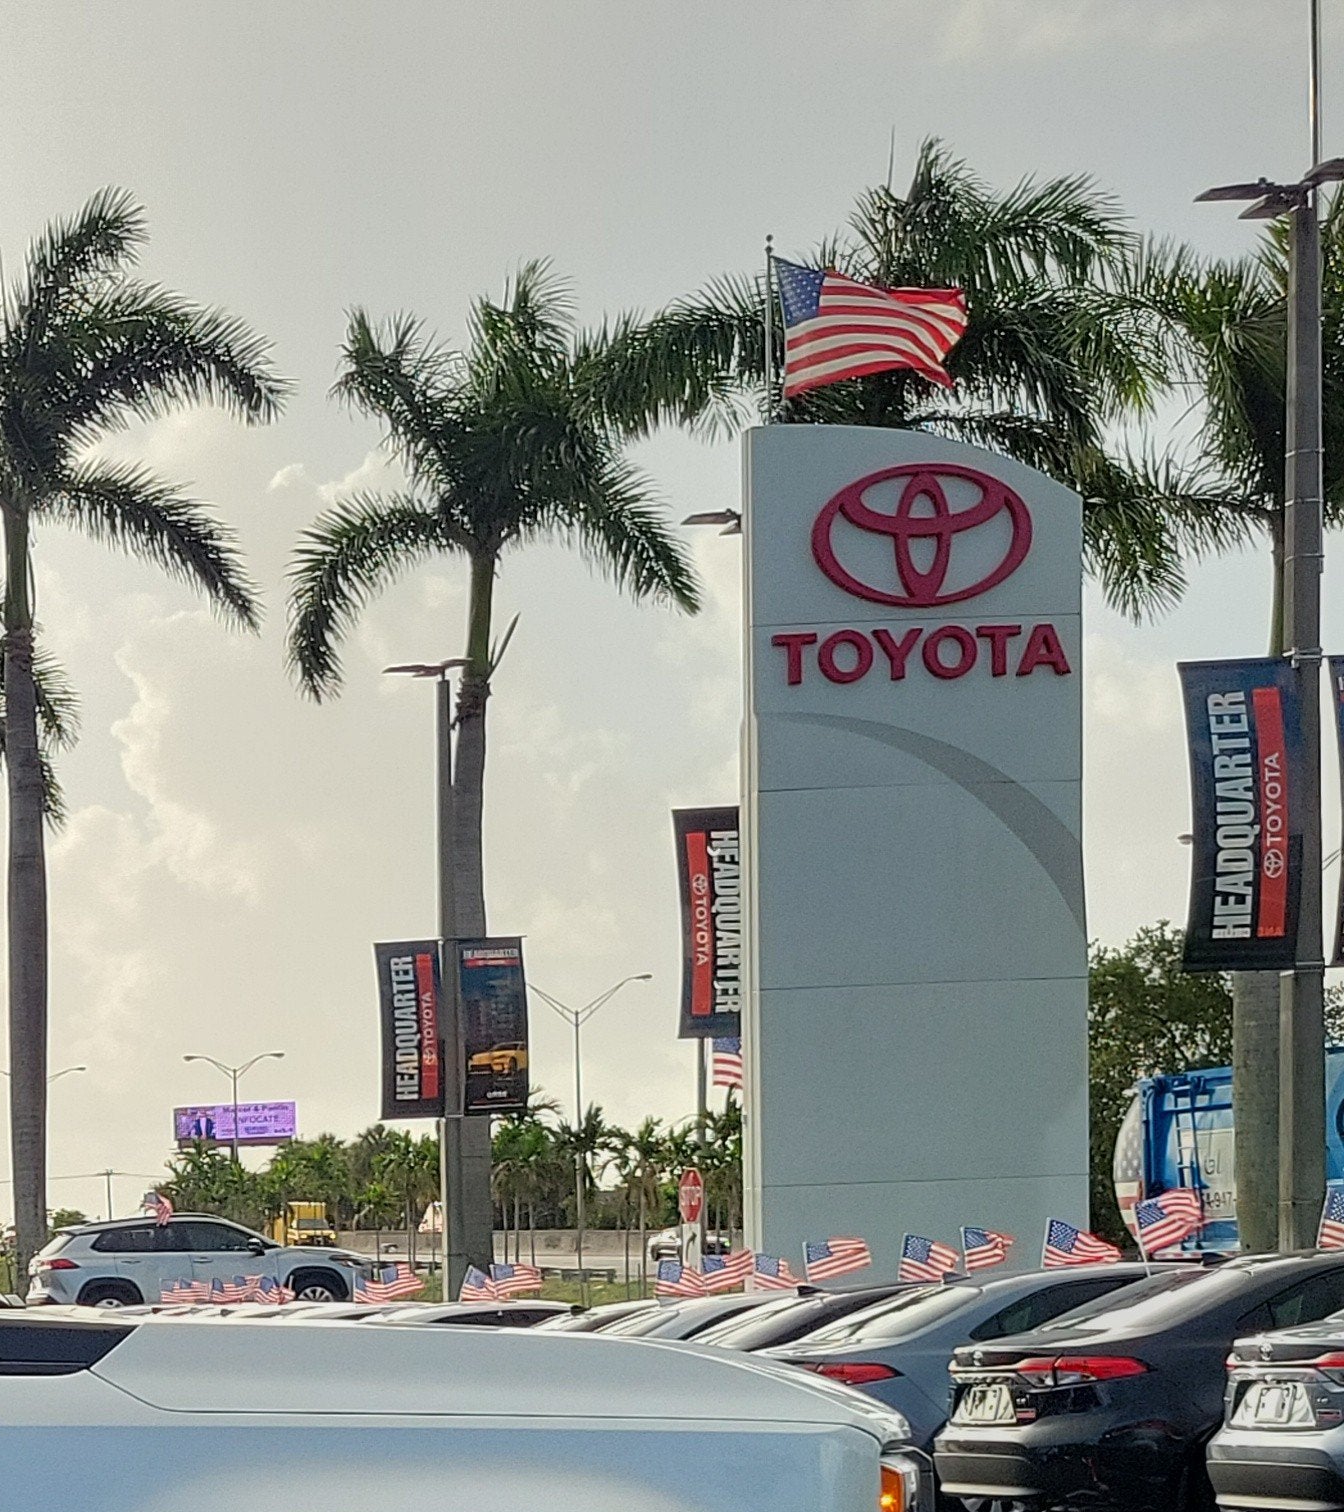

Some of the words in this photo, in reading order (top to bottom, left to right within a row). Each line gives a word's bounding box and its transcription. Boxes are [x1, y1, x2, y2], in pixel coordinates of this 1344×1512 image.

[771, 623, 1072, 686] TOYOTA
[1207, 691, 1260, 939] HEADQUARTER
[1264, 752, 1282, 847] TOYOTA
[695, 898, 710, 966] TOYOTA
[710, 830, 741, 1014] HEADQUARTER
[390, 956, 420, 1100] HEADQUARTER
[422, 992, 434, 1046] TOYOTA
